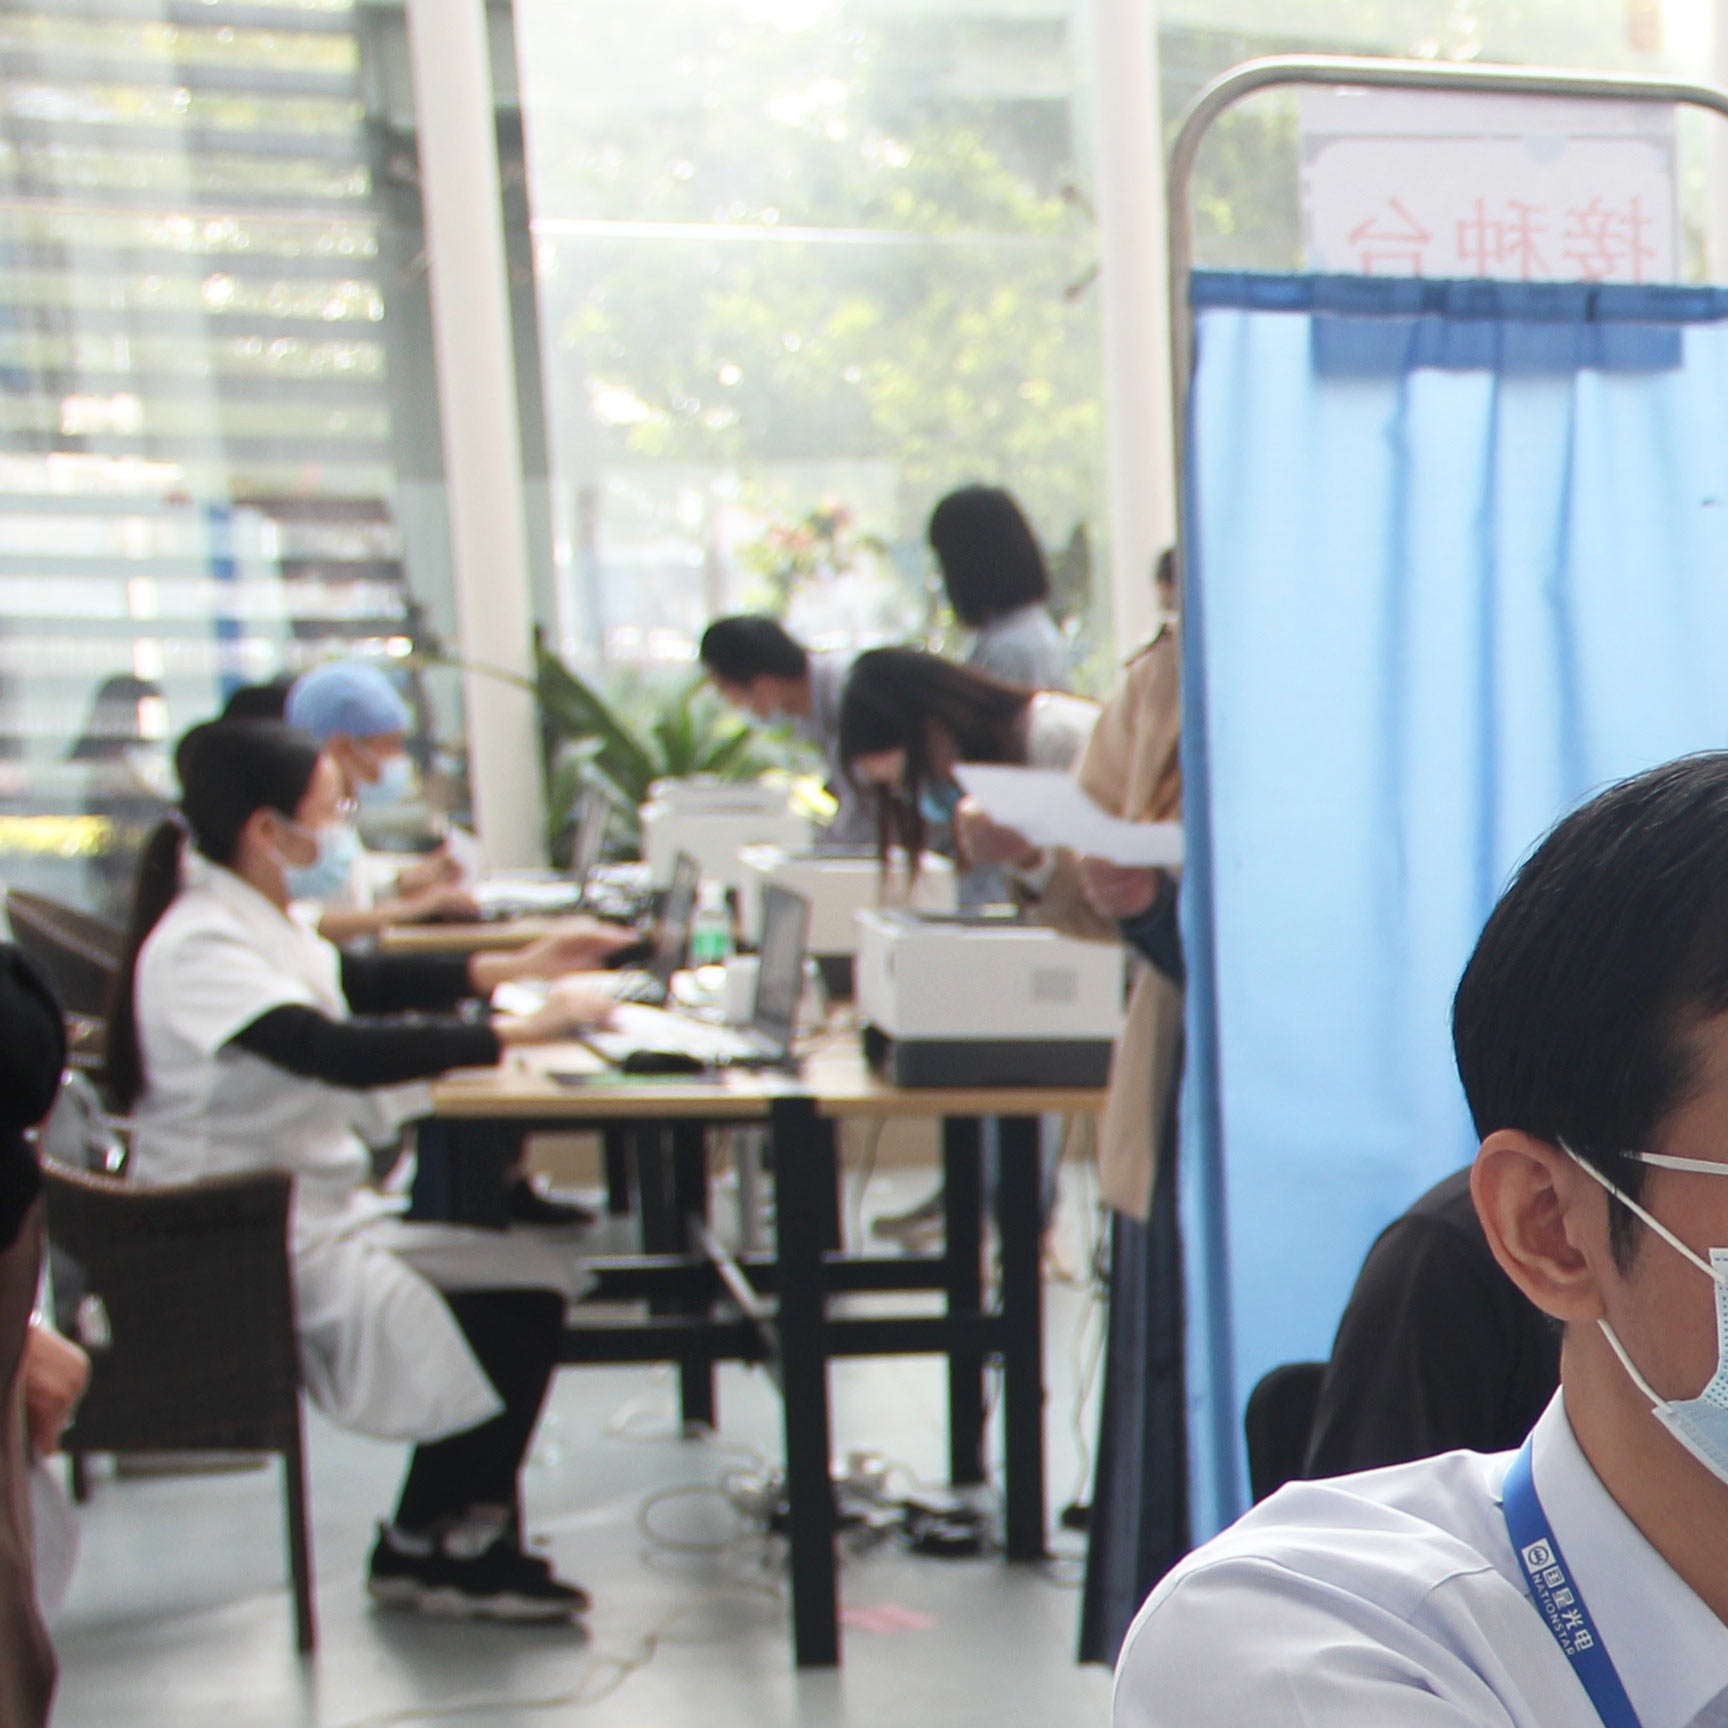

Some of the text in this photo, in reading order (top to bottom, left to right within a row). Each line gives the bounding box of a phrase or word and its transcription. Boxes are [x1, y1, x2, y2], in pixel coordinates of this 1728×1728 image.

[1531, 1572, 1576, 1656] NATIONSTAR
[1542, 1565, 1594, 1652] 国星光电
